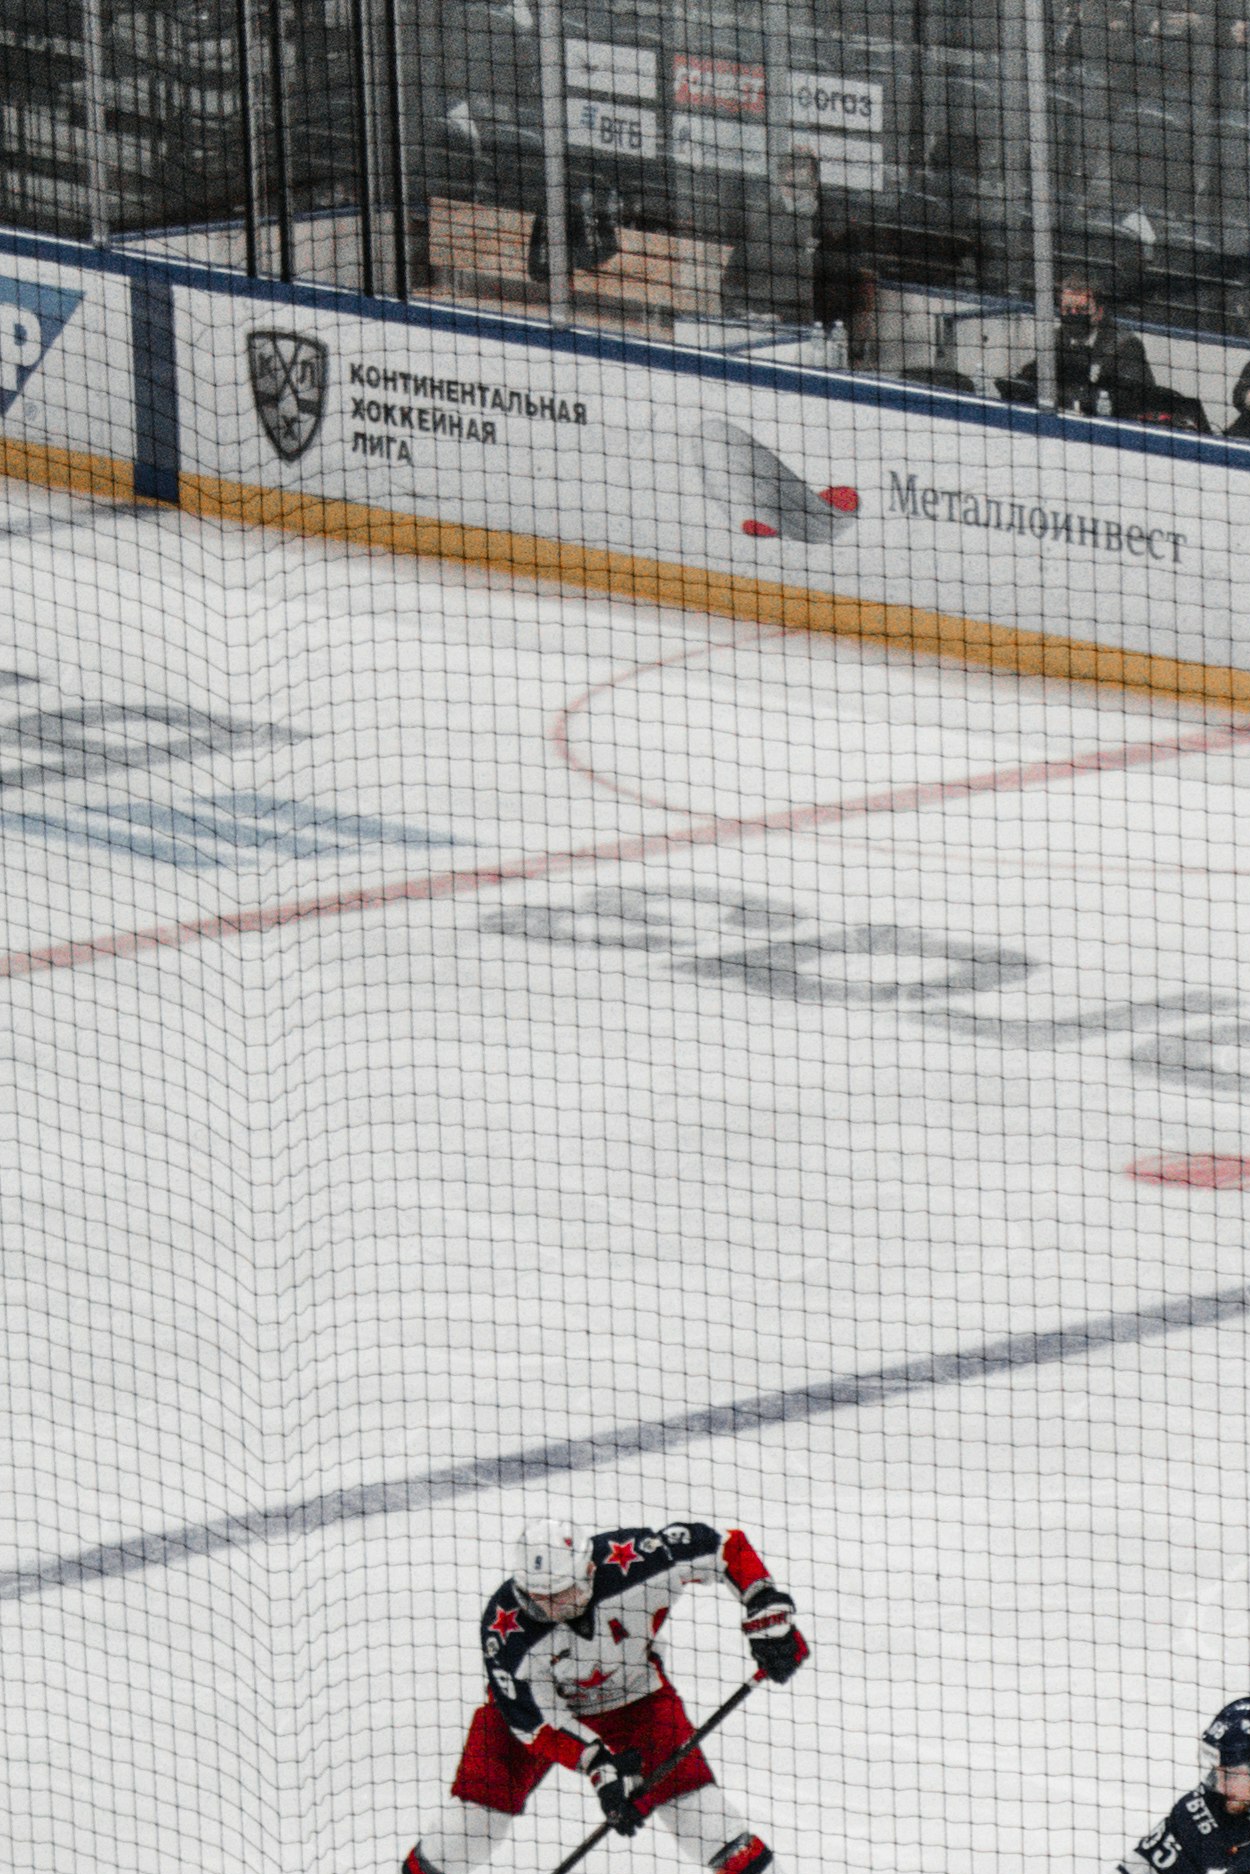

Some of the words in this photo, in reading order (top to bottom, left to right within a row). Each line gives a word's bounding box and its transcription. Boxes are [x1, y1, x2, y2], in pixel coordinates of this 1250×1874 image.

[350, 362, 588, 426] КОНТИНЕНТАЛЬНАЯ
[351, 396, 497, 446] ХОККЕЙНАЯ
[352, 431, 413, 465] ЛИГА
[888, 470, 1188, 563] Металлоинвест
[1186, 1797, 1219, 1834] ВТБ
